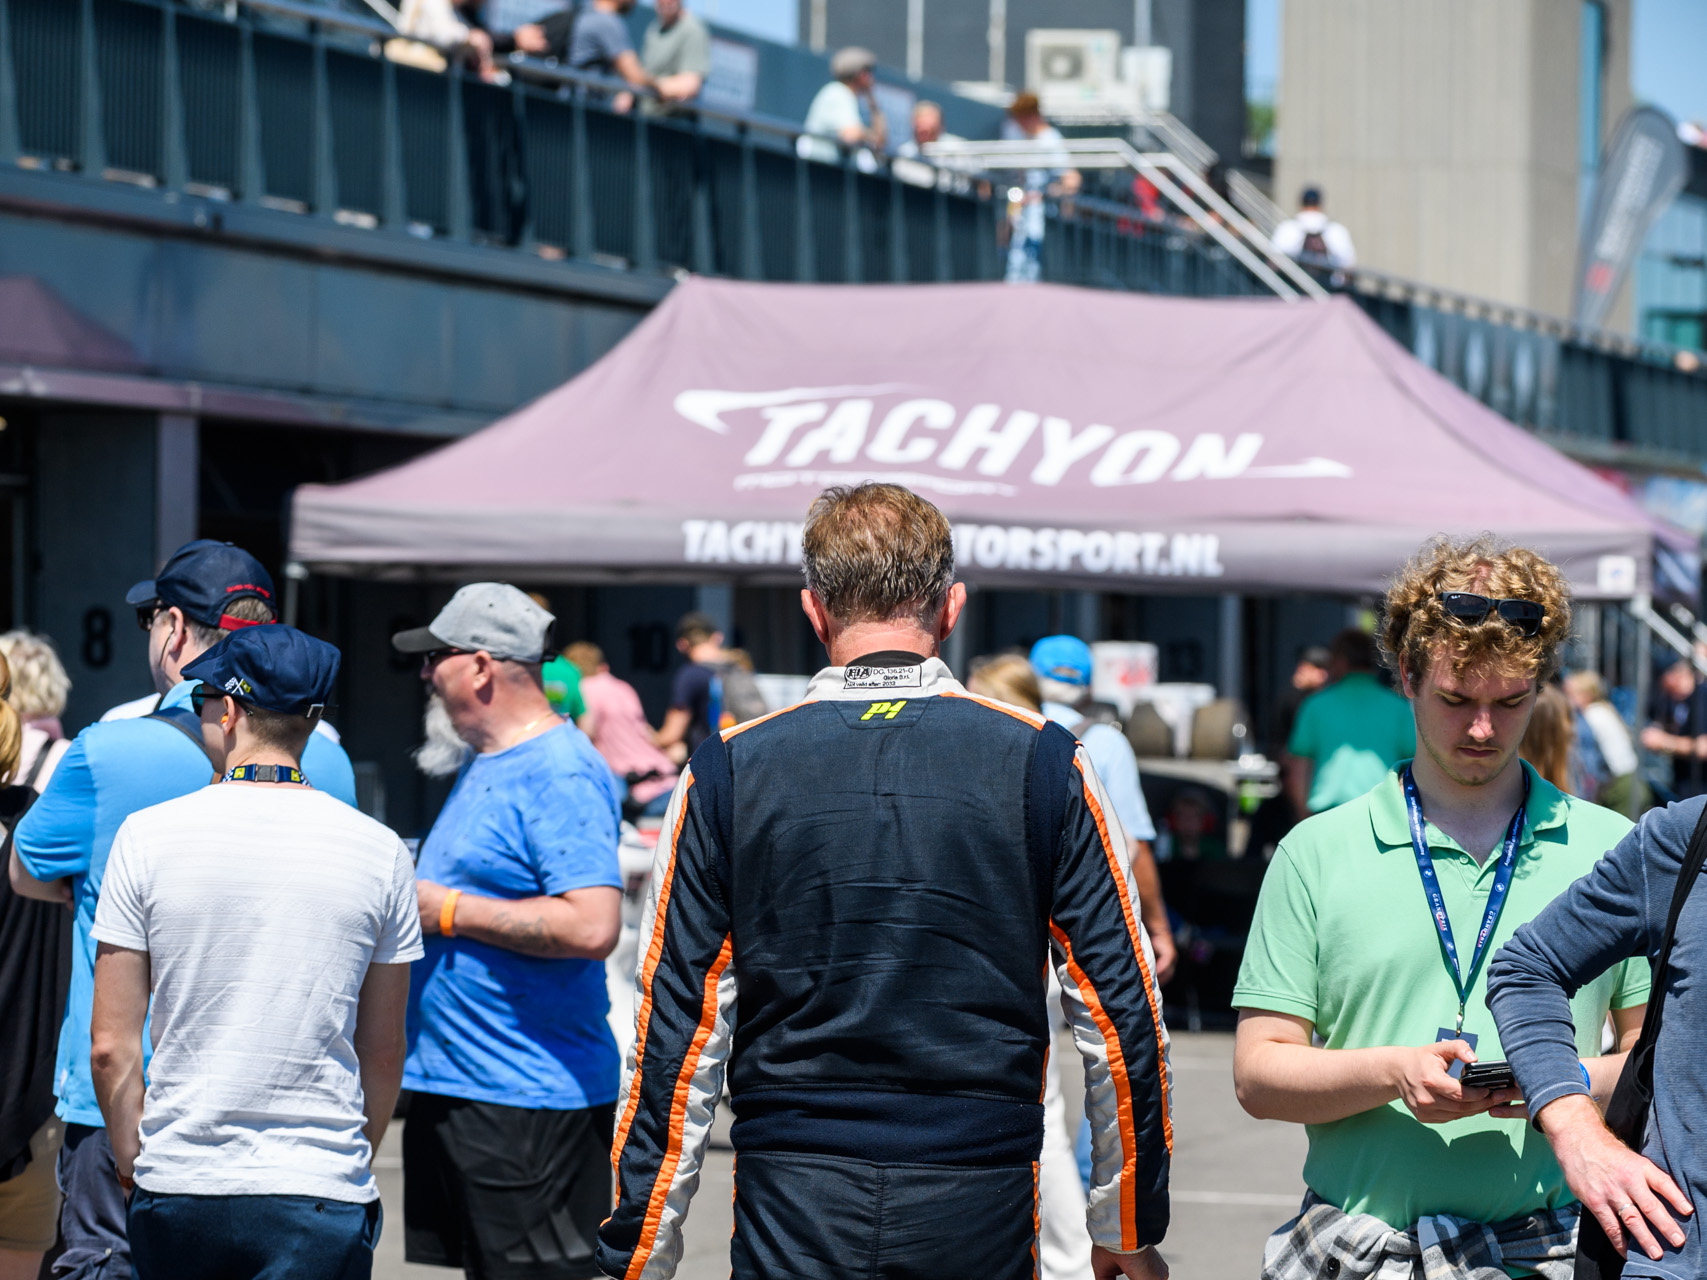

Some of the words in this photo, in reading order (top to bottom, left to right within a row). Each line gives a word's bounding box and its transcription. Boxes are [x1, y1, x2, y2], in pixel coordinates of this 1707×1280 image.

[744, 398, 1265, 487] TACHYON
[682, 519, 1224, 577] TACHYTORSPORT.NL
[83, 607, 111, 669] 8
[627, 621, 671, 673] 10
[860, 700, 907, 720] P1
